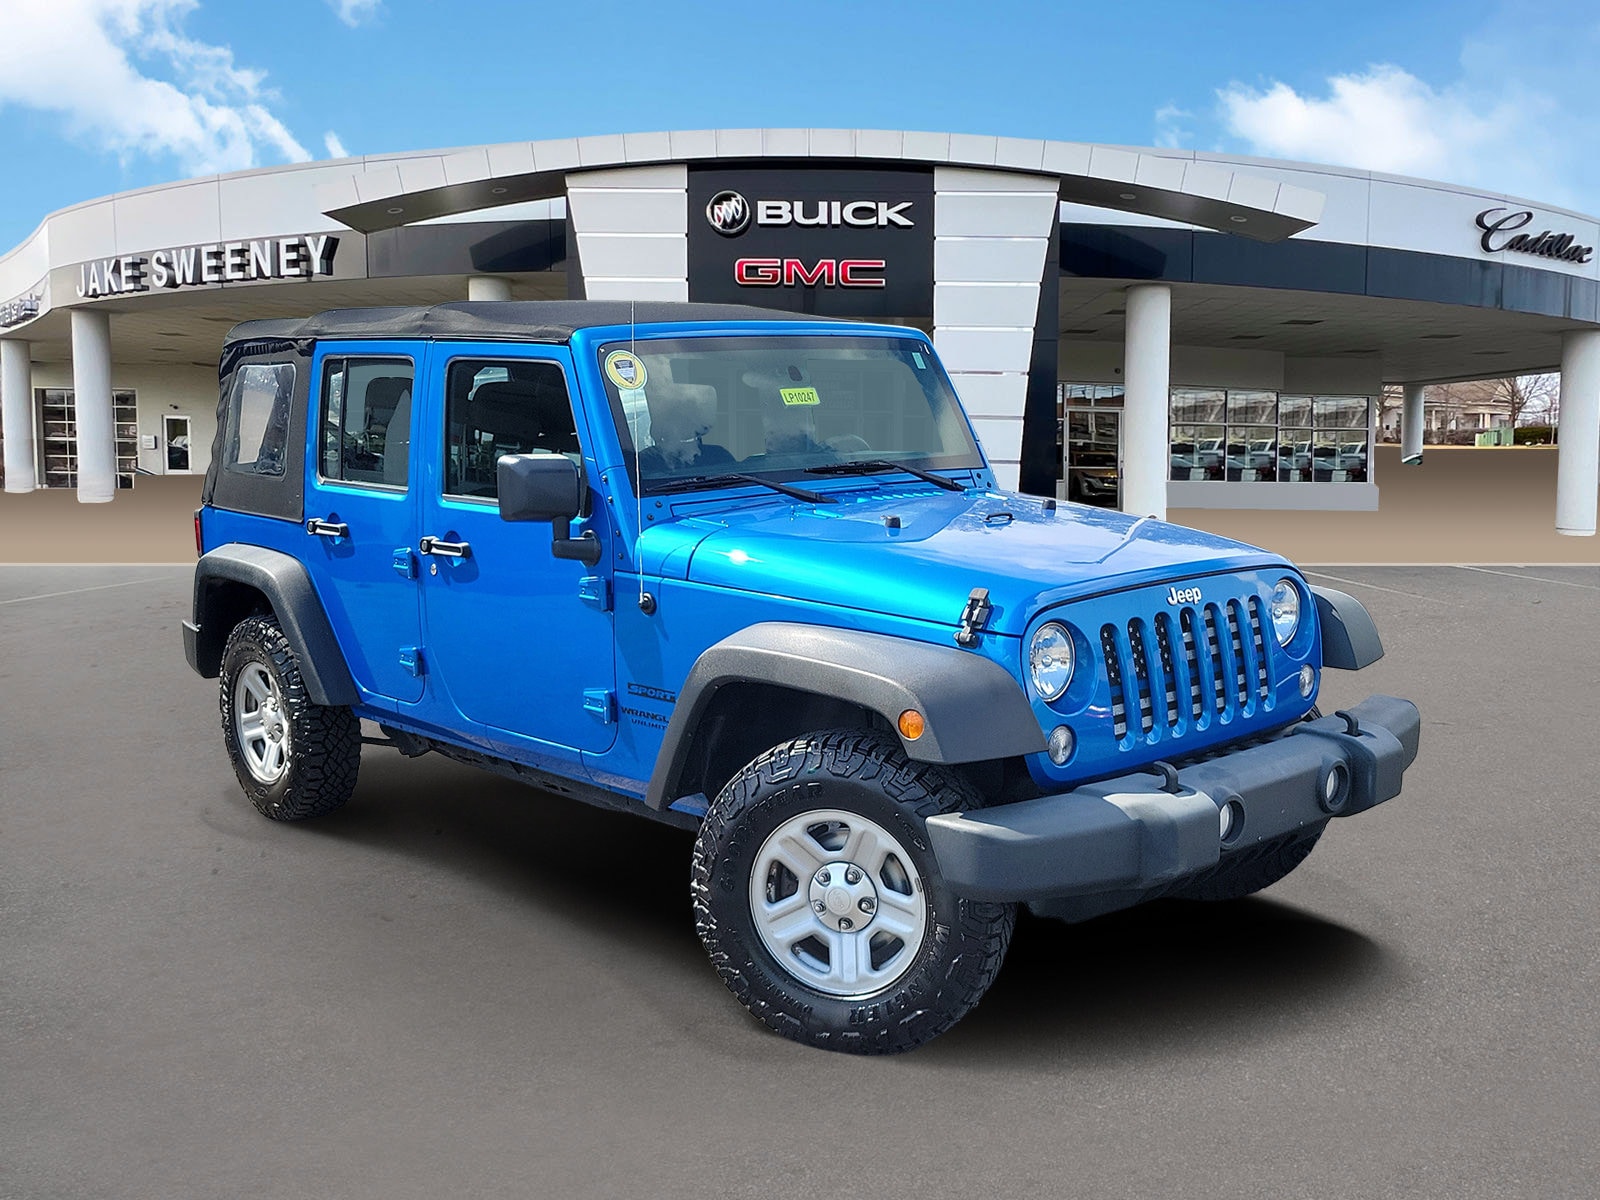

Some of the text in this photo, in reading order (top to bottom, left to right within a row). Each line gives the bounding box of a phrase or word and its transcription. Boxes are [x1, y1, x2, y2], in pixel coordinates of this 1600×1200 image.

[756, 200, 914, 226] BUICK
[1475, 207, 1593, 264] Cadillac
[76, 235, 333, 298] JAKE SWEENEY
[734, 258, 886, 287] GMC
[783, 391, 817, 404] LP10247
[1166, 586, 1202, 606] Jeep
[627, 682, 676, 703] SPORT
[621, 706, 669, 724] WRANGL
[631, 718, 668, 730] UNLIMIT
